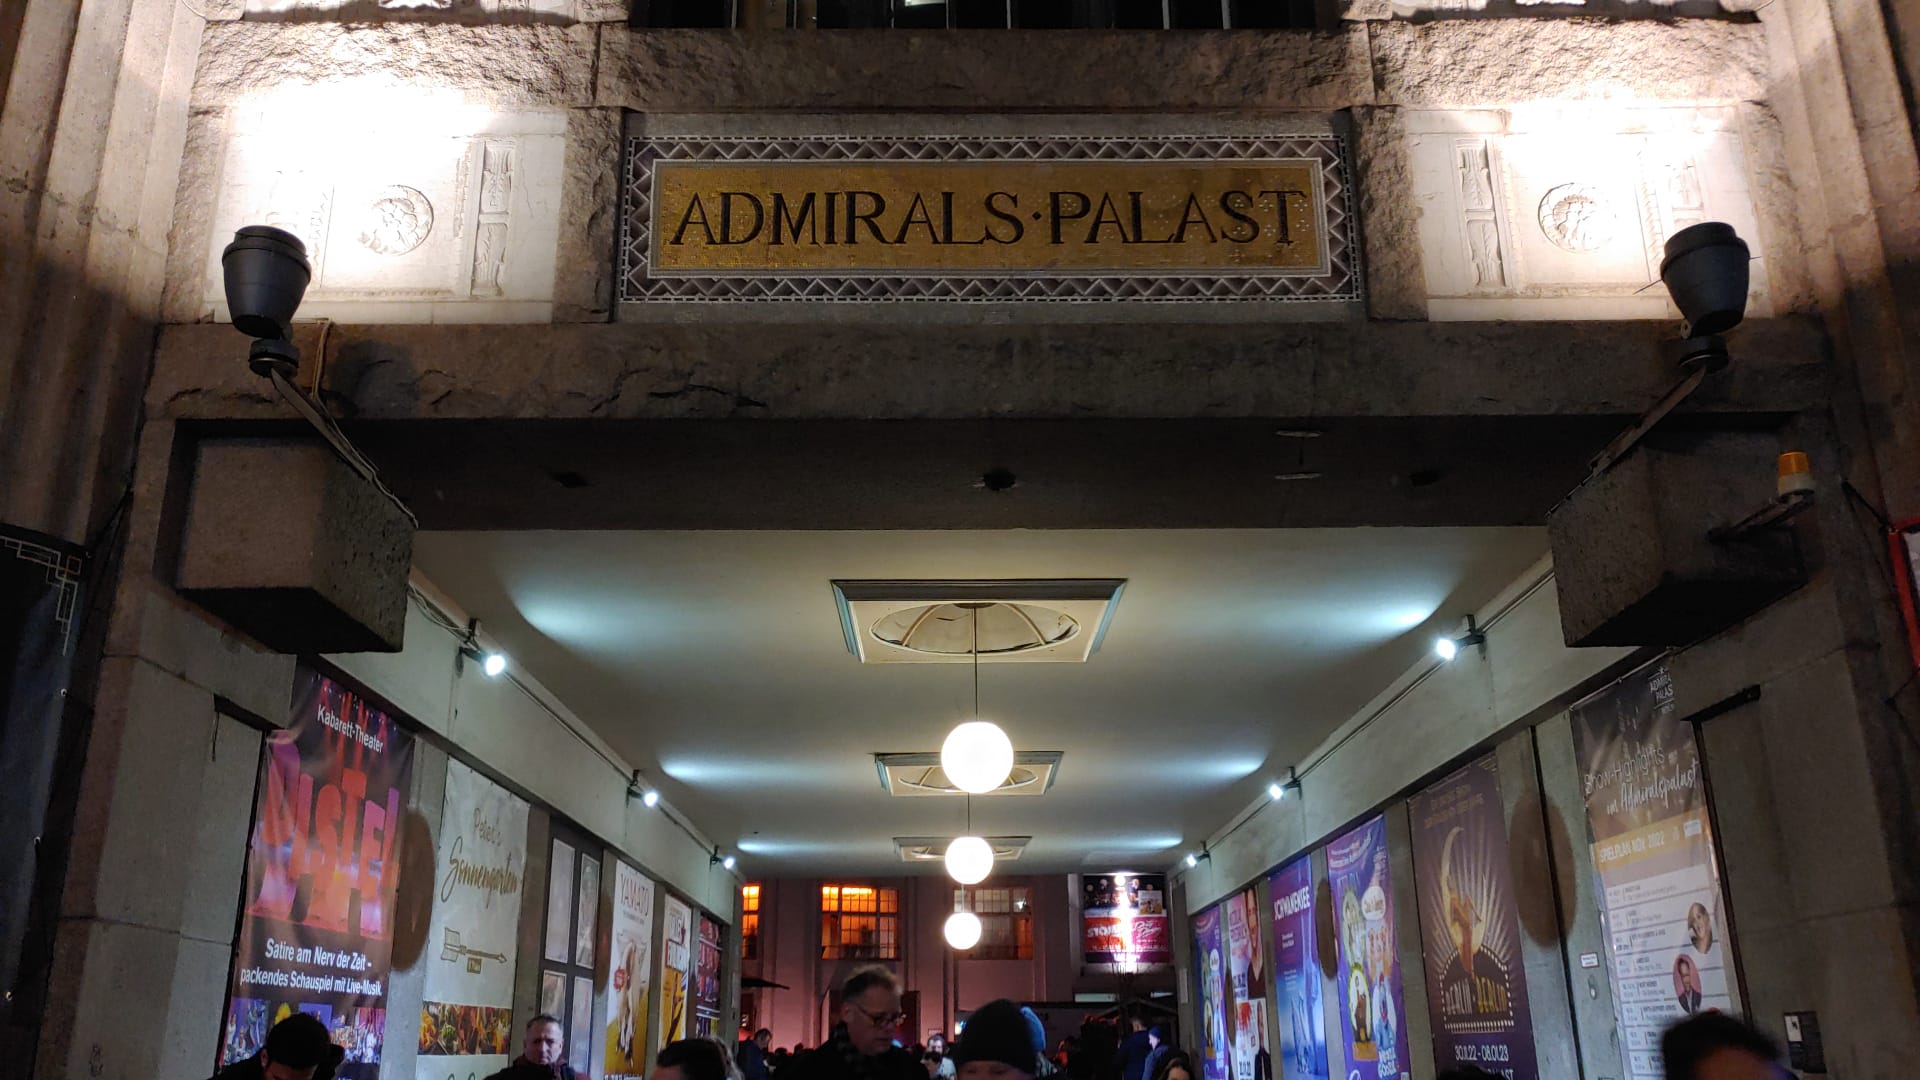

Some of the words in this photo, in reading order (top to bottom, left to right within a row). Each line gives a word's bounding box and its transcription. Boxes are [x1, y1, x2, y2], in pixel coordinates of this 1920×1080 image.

[317, 704, 384, 754] Kabarett-Theater
[265, 937, 295, 962] Satire
[296, 947, 312, 963] am
[313, 945, 335, 966] Nerv
[336, 952, 350, 969] der
[350, 952, 366, 972] Zeit
[240, 966, 289, 987] packendes
[290, 970, 334, 994] Schauspiel
[334, 978, 346, 992] mit
